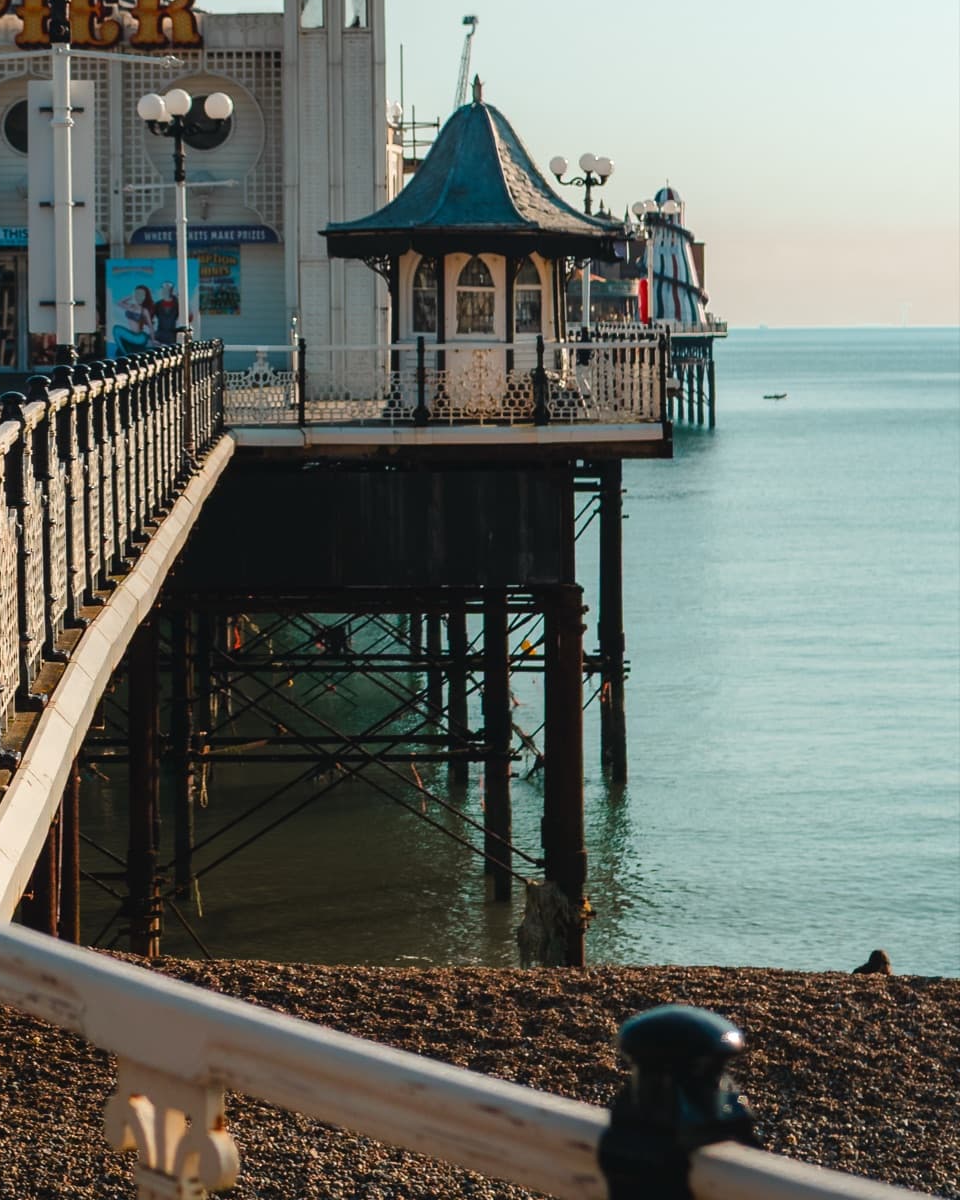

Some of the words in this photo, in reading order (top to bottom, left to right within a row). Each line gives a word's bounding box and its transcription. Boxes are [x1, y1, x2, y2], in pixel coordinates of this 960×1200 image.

[144, 231, 172, 241] WHERE
[210, 230, 235, 241] MAKE
[237, 230, 266, 241] PRIZES
